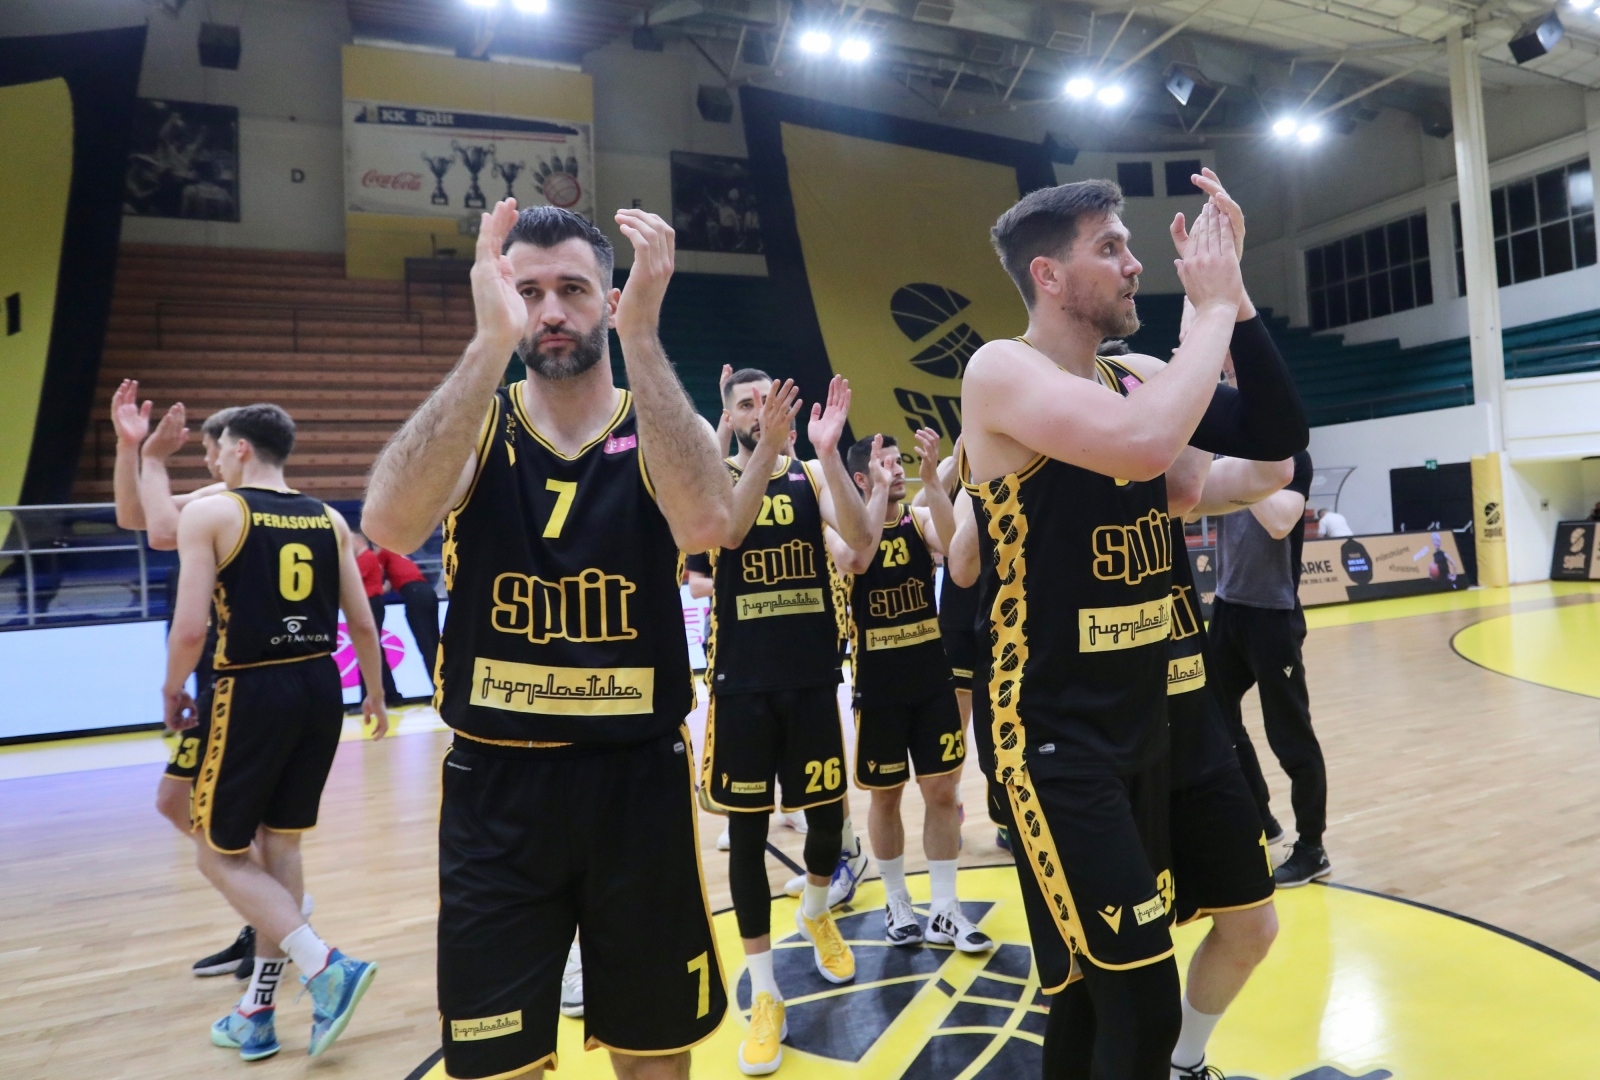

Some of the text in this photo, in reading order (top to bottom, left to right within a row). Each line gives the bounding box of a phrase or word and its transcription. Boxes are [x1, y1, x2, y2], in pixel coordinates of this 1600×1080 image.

[380, 110, 454, 126] KK Split
[252, 512, 332, 530] PERASOVIĆ
[542, 478, 577, 539] 7
[756, 494, 794, 526] 26
[742, 539, 817, 585] split
[880, 537, 911, 568] 23
[279, 543, 314, 602] 6
[492, 568, 638, 644] split
[868, 577, 929, 619] split
[939, 729, 965, 762] 23
[805, 757, 841, 793] 26
[687, 951, 710, 1020] 7
